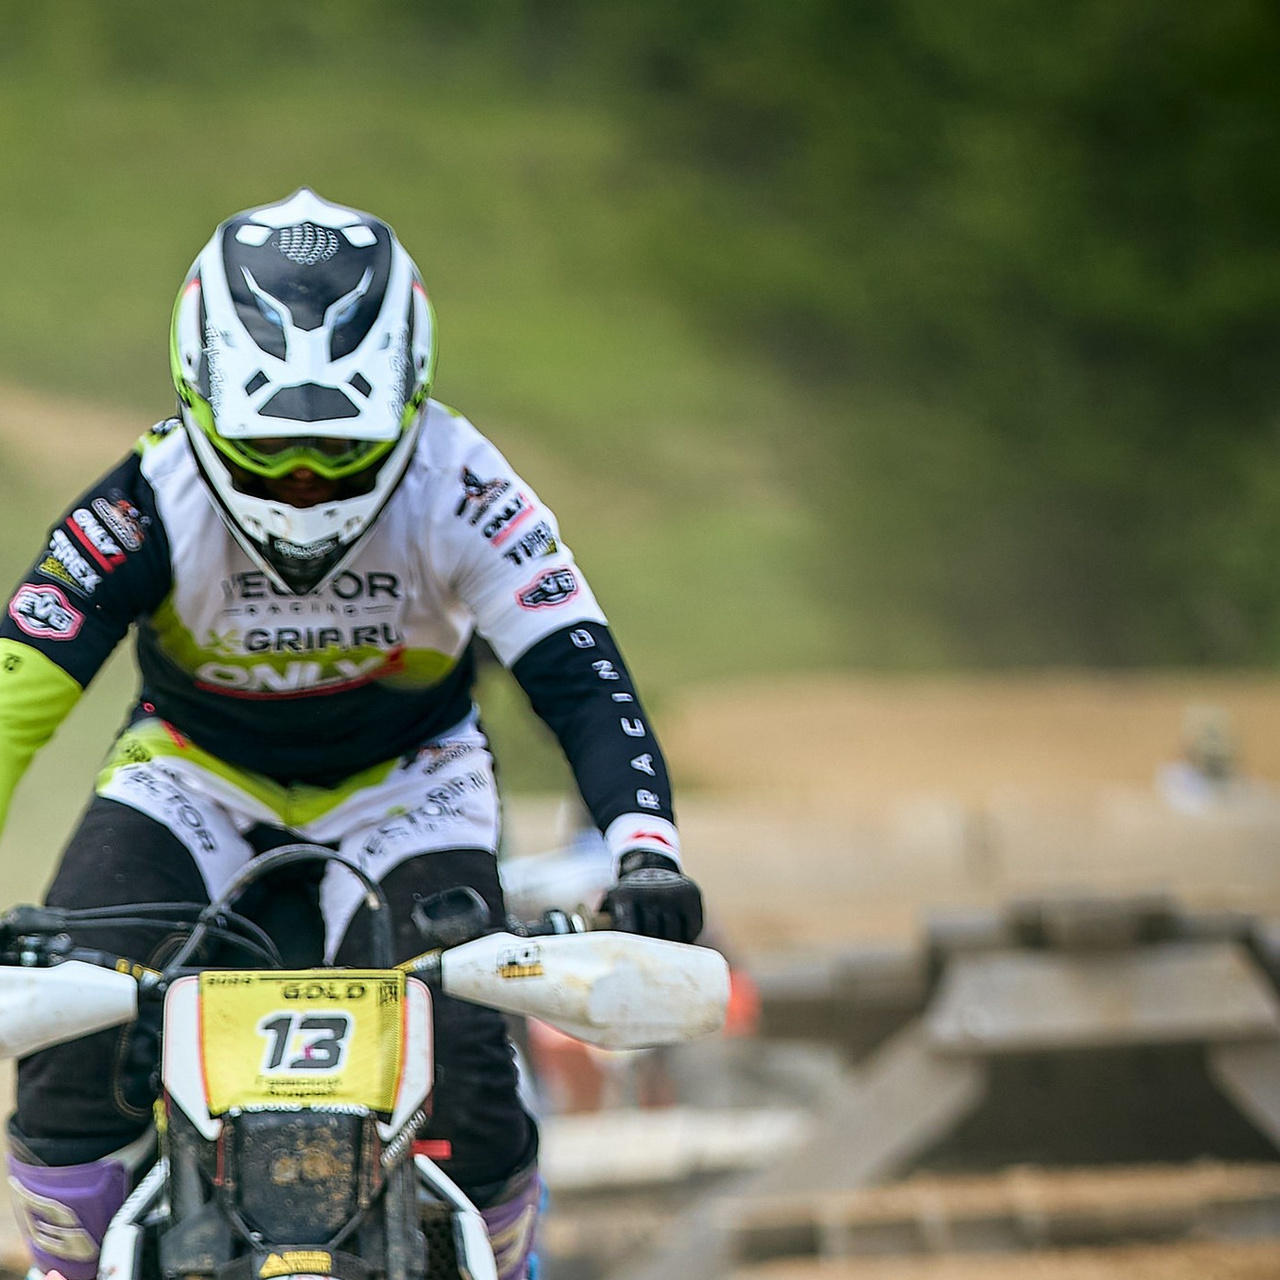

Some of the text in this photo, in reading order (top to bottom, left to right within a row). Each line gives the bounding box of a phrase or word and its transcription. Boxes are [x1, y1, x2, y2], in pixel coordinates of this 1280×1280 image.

[222, 570, 401, 601] VEOR
[569, 628, 662, 811] RACING
[284, 982, 367, 1000] GOLD
[261, 1016, 349, 1069] 13
